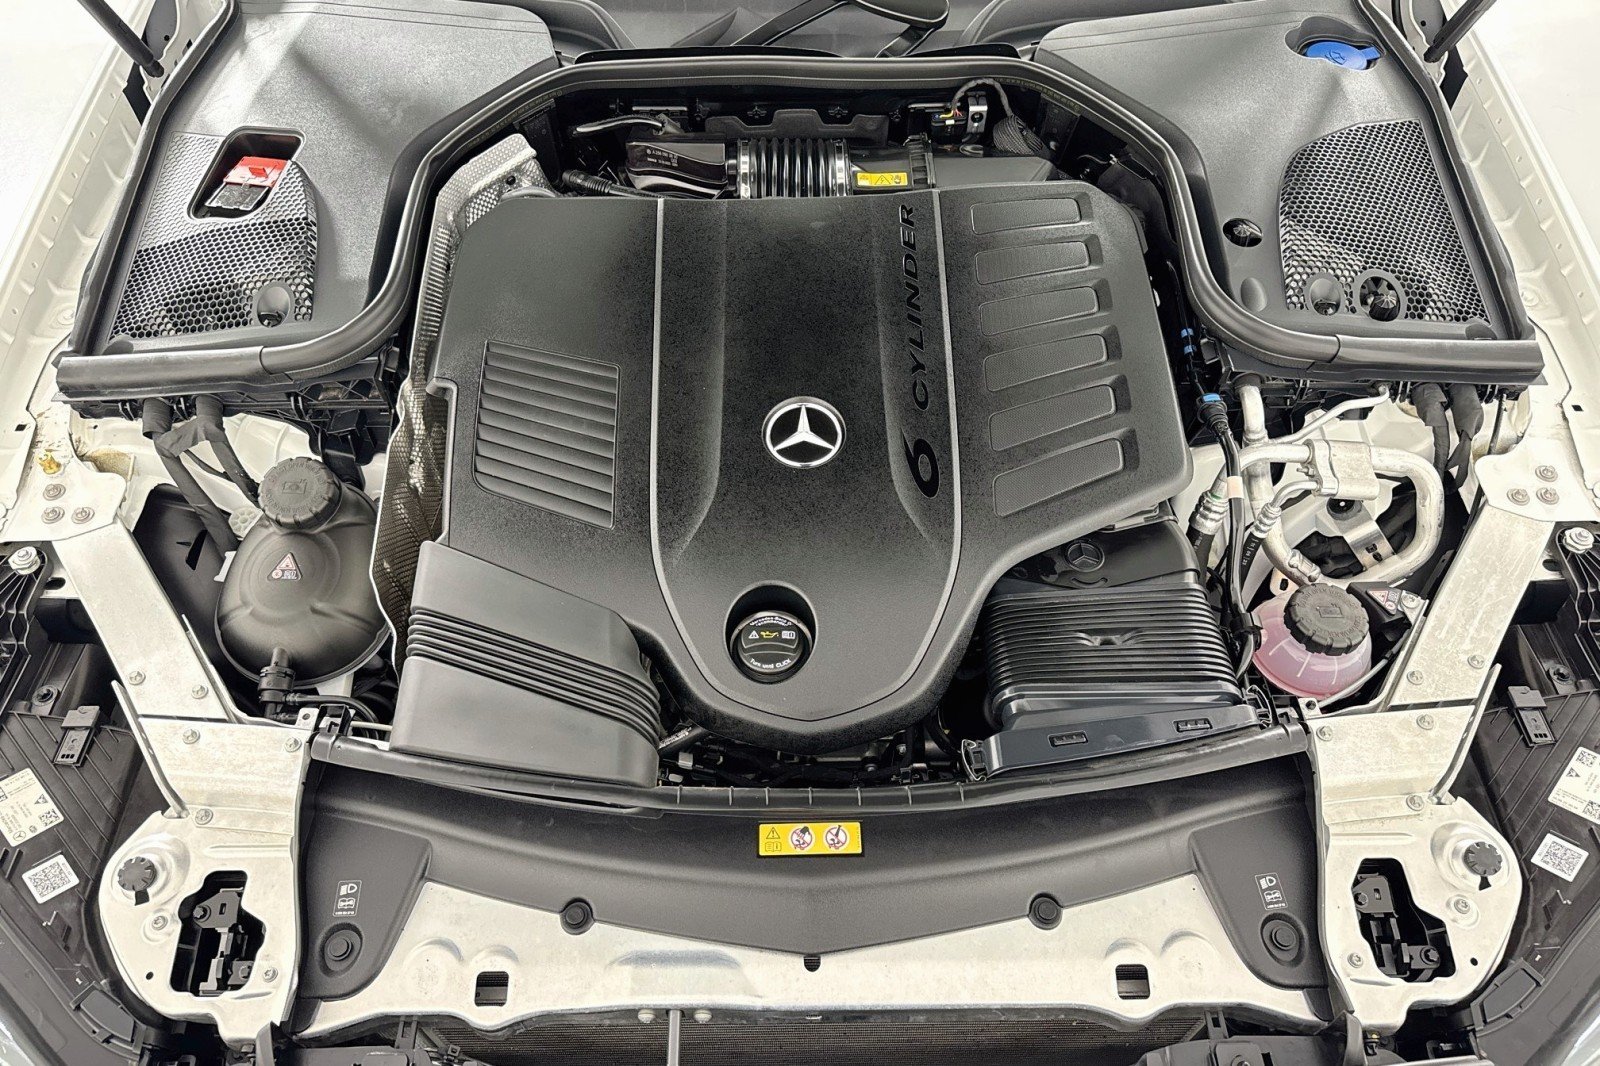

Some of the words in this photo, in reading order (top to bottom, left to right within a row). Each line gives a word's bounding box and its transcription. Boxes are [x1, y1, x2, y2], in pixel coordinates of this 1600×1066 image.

[899, 204, 930, 411] CYLINDER
[900, 428, 940, 499] 6
[750, 658, 761, 667] Turn
[776, 658, 792, 668] CLICK
